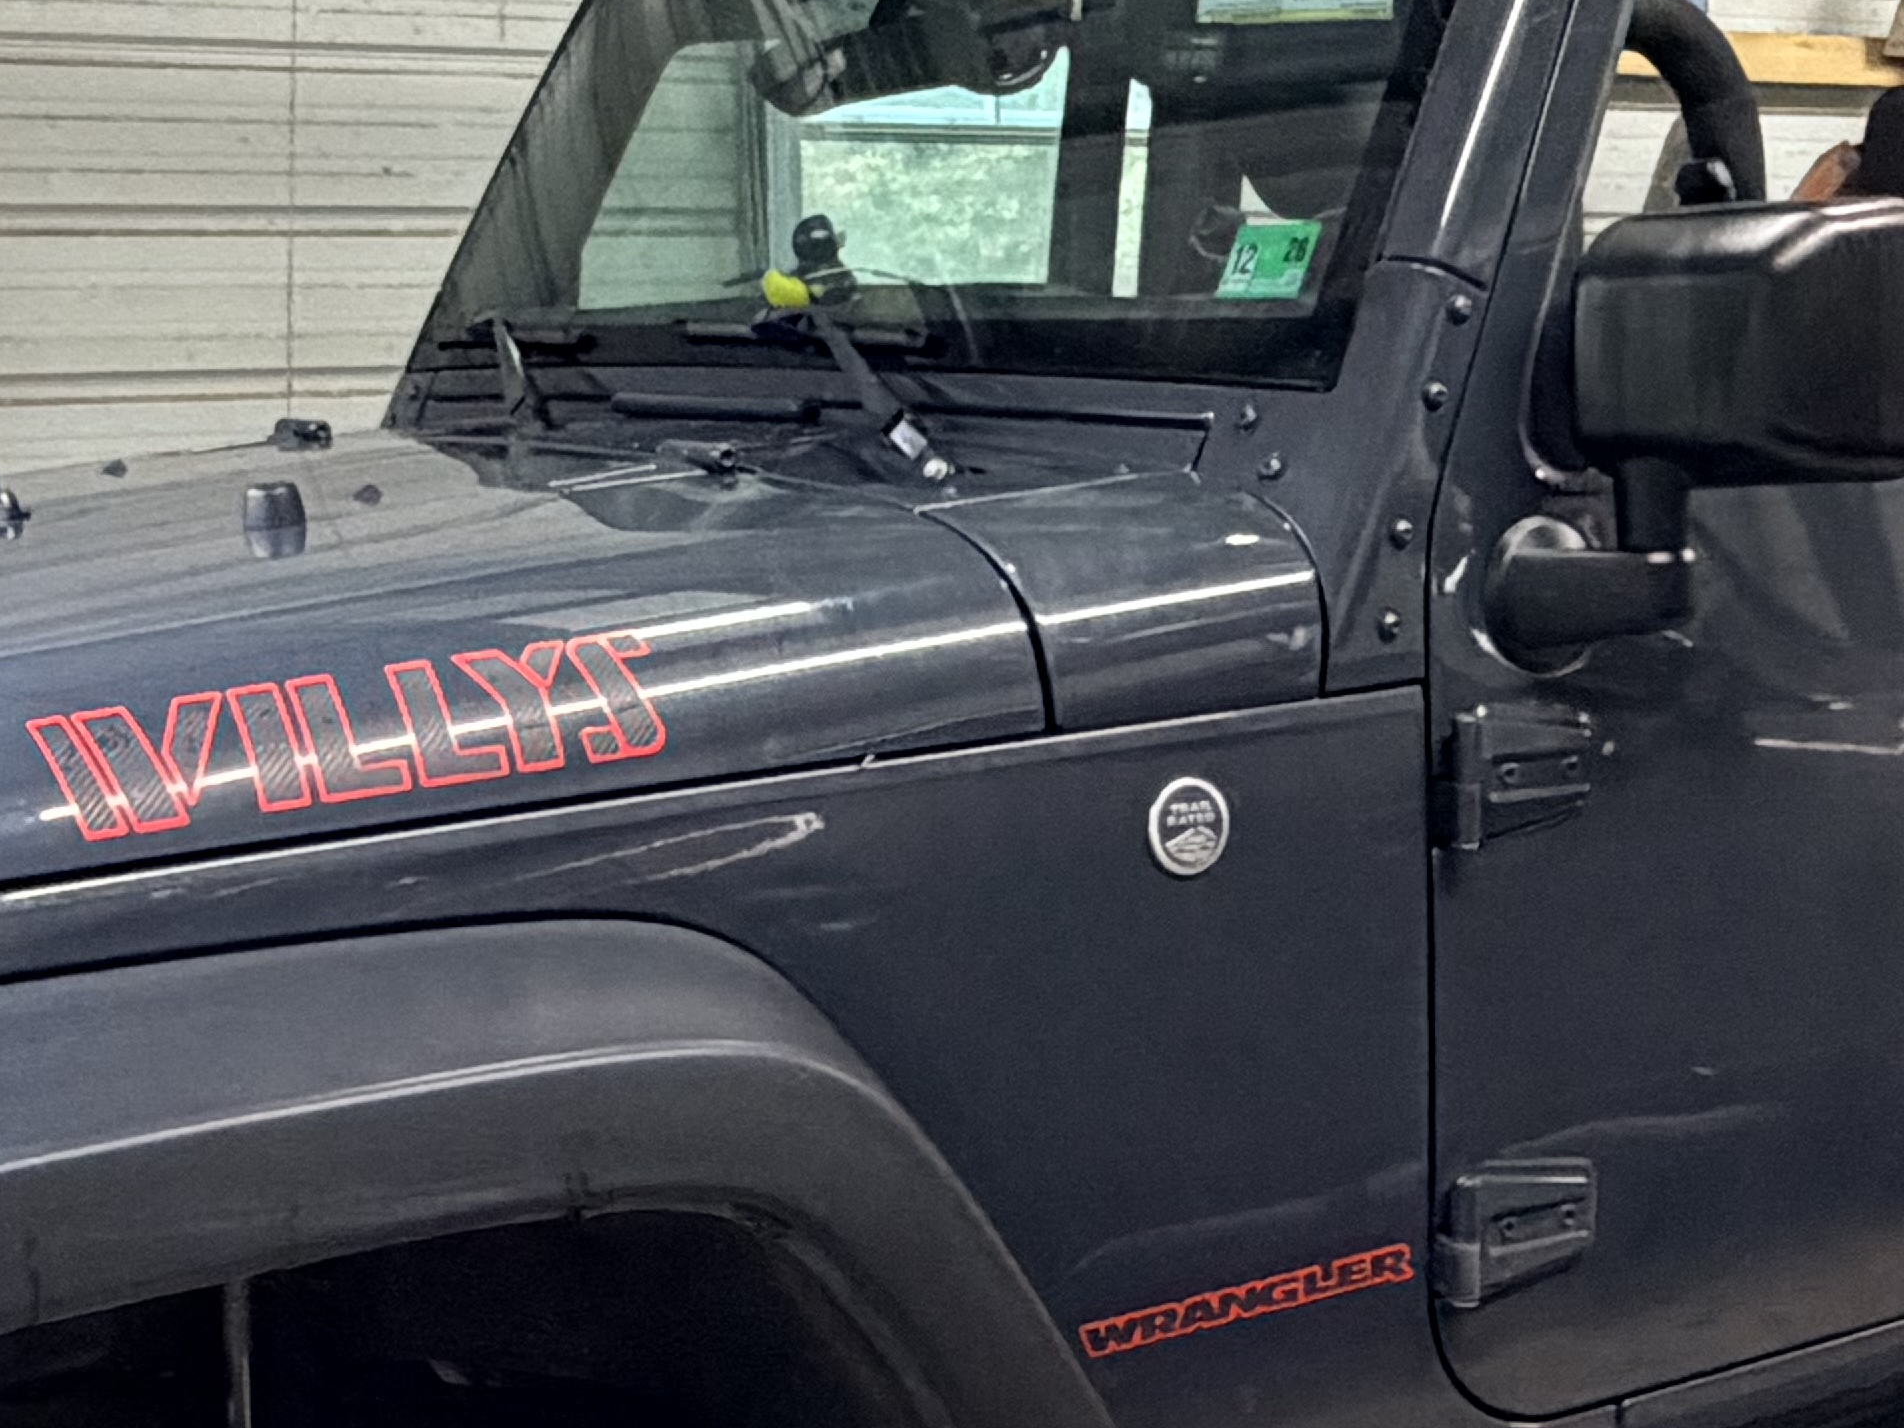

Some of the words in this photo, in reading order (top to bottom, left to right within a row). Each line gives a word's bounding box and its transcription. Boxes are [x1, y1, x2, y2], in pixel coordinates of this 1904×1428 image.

[1231, 242, 1258, 274] 12
[25, 629, 667, 842] WILLYS
[1078, 1242, 1415, 1359] WRANGLER
